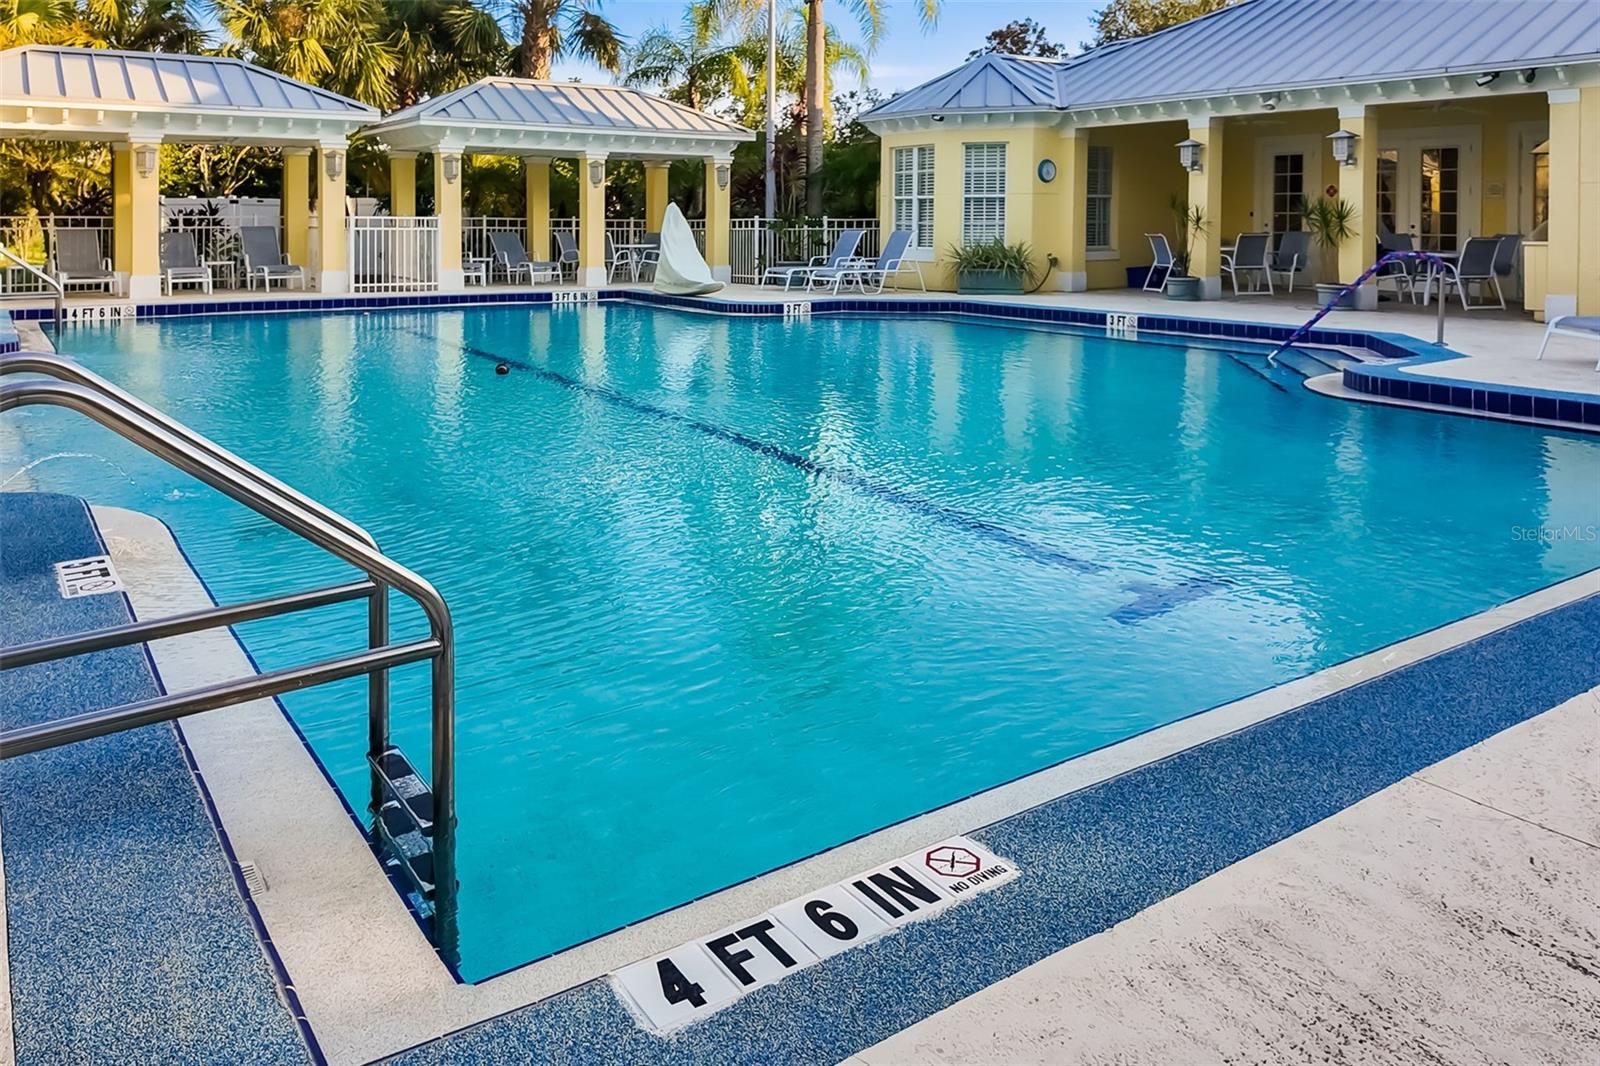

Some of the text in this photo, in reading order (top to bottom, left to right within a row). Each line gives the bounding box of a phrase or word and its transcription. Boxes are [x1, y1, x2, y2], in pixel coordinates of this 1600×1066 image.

[562, 292, 570, 301] FT
[580, 292, 588, 301] IN
[72, 306, 121, 319] 4 FT 6 IN
[786, 303, 801, 314] 3 FT
[1110, 315, 1115, 326] 3
[1117, 315, 1126, 327] FT
[62, 559, 111, 583] 5 FT
[948, 864, 1008, 894] NO DIVING
[656, 866, 943, 1009] 4 FT 6 IN
